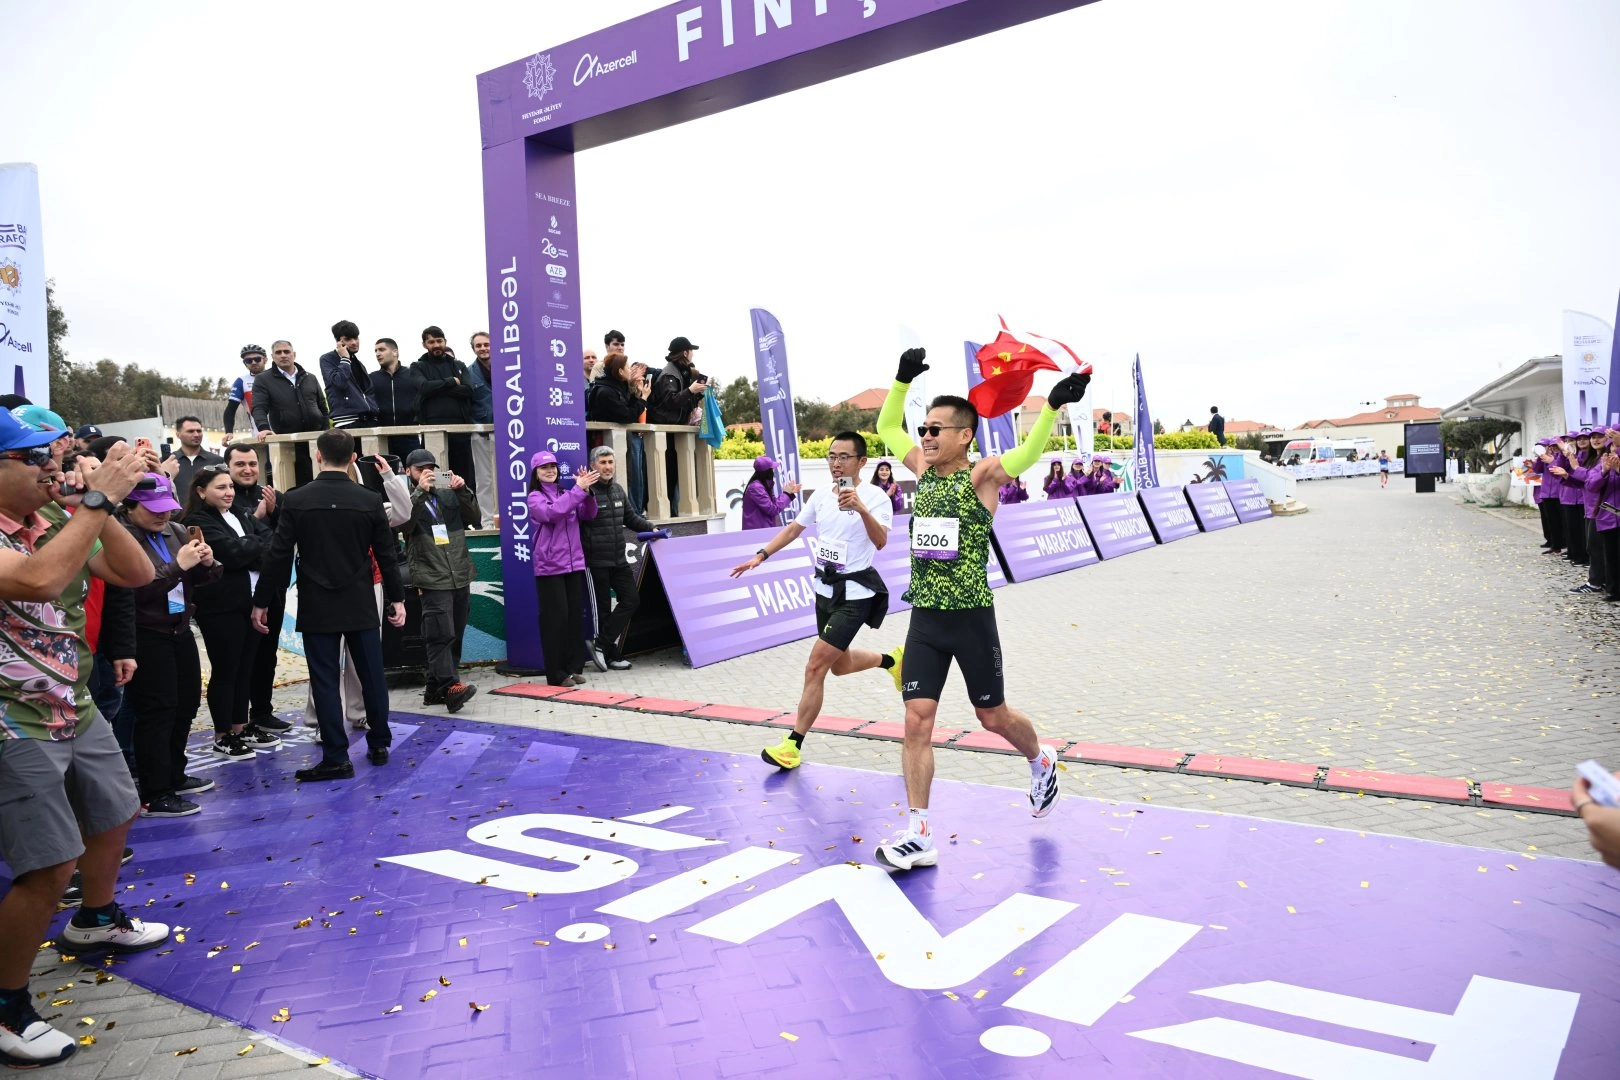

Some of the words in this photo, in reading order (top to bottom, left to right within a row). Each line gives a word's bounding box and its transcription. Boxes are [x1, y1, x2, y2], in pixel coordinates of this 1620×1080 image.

[595, 50, 638, 77] Azercell
[533, 114, 552, 124] FONDU
[534, 192, 547, 201] SEA
[547, 195, 571, 208] BREEZE
[550, 266, 563, 276] AZE
[546, 417, 562, 426] TAN
[1056, 504, 1084, 526] BAKI
[916, 534, 948, 546] 5206
[1036, 528, 1093, 556] MARAFONU
[820, 548, 838, 560] 5315
[754, 573, 816, 616] MARA
